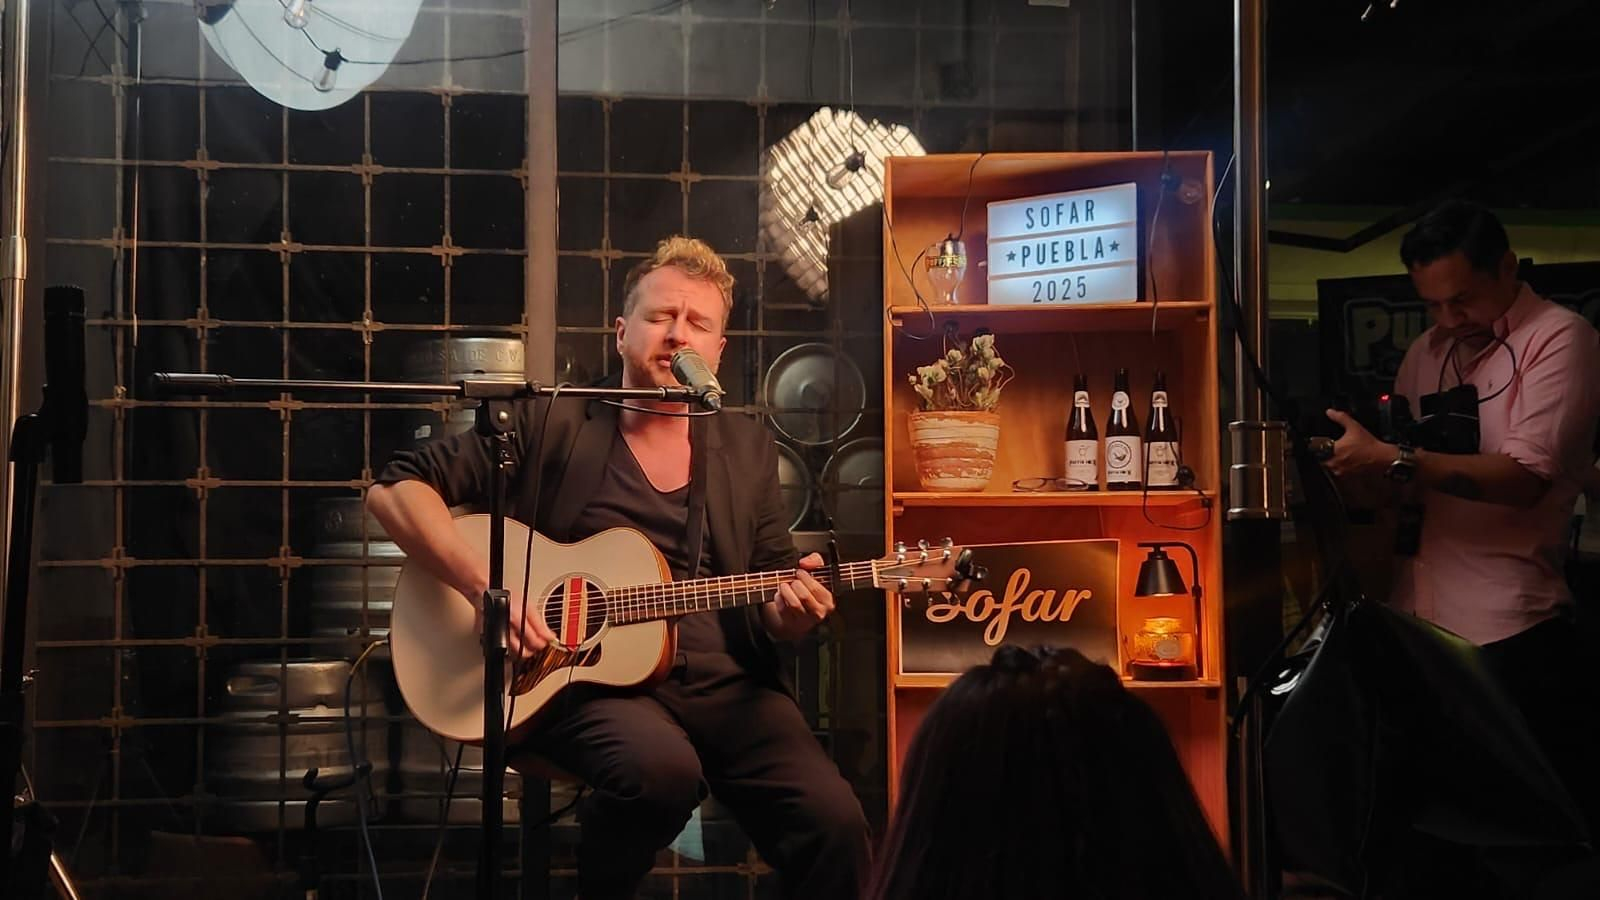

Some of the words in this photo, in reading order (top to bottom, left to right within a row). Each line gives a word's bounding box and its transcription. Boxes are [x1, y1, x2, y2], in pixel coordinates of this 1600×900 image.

[1025, 199, 1095, 229] SOFAR
[1021, 236, 1105, 268] PUEBLA
[1033, 276, 1087, 303] 2025
